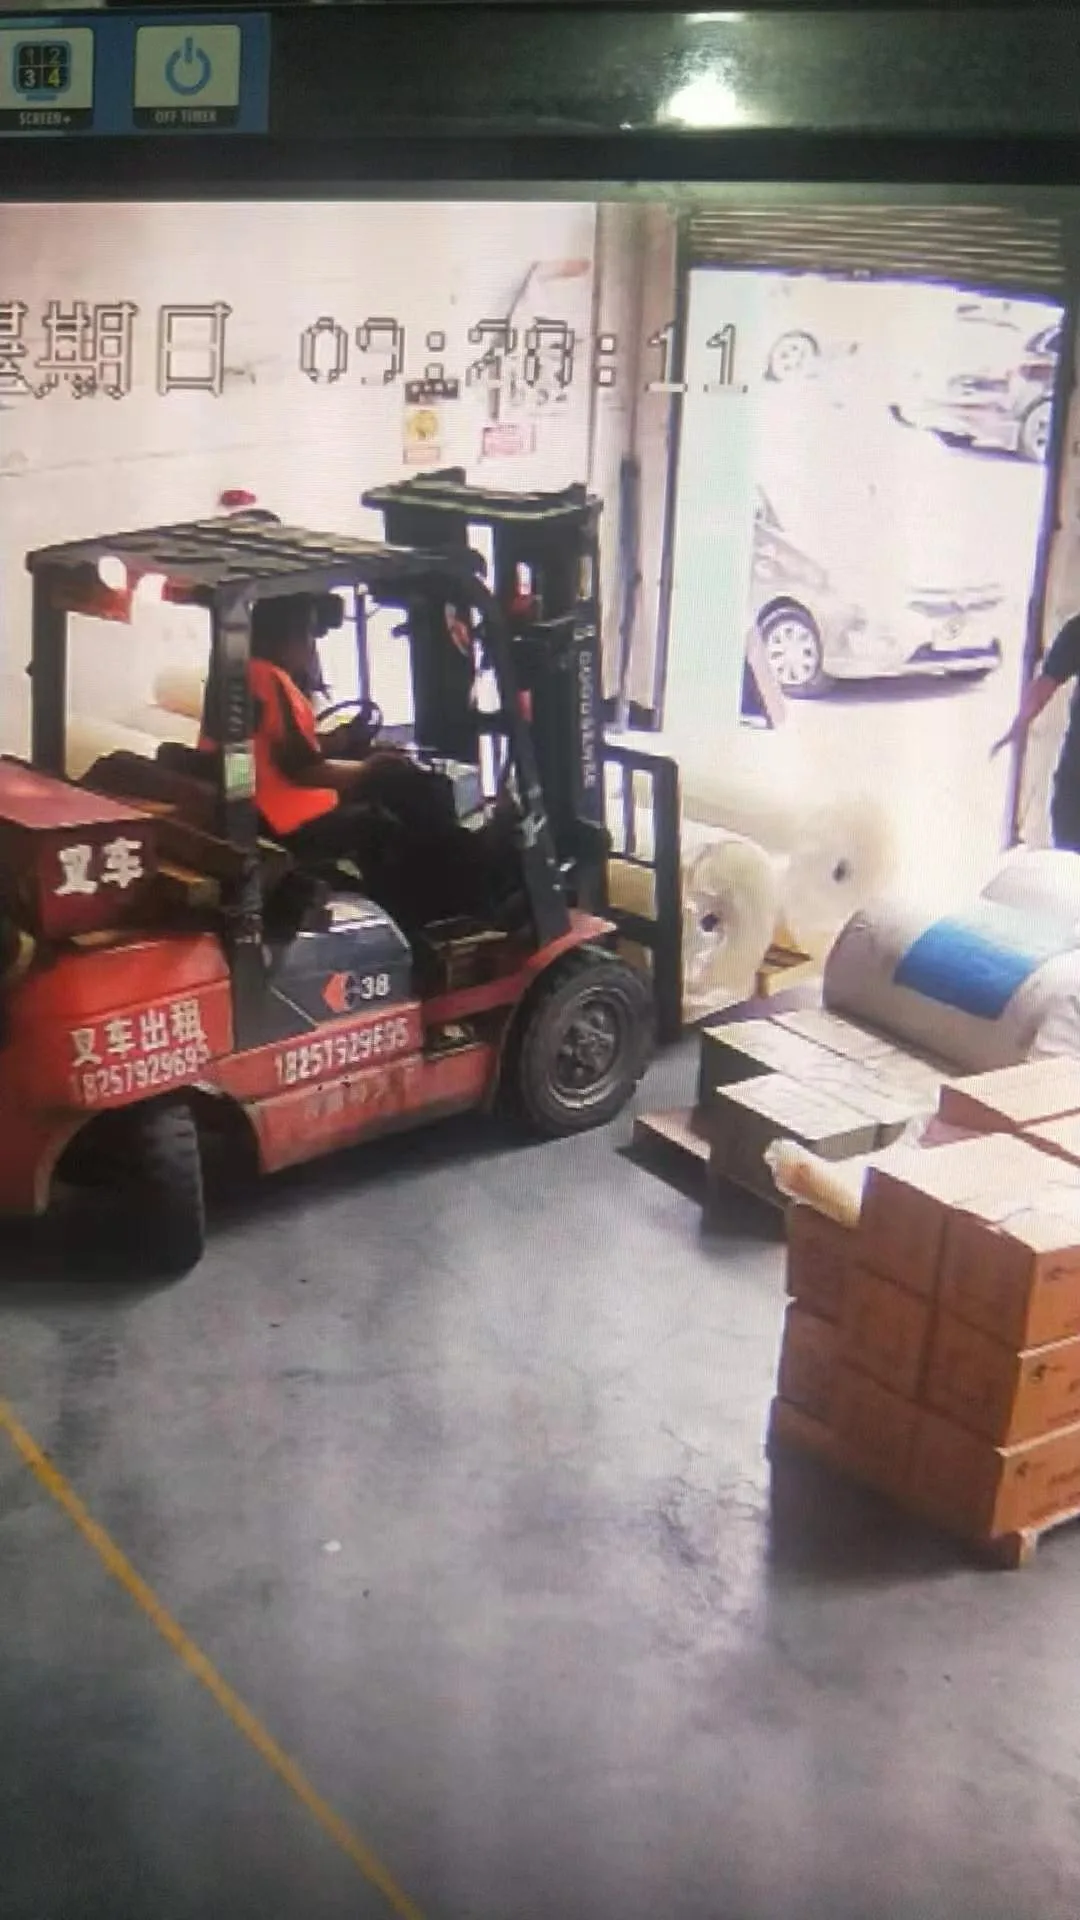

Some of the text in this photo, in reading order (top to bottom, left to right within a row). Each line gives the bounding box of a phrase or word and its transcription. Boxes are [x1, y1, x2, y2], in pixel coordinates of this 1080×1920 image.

[24, 67, 60, 88] 3 4
[155, 109, 216, 123] OFF TIMER
[0, 299, 232, 400] 期日
[55, 837, 144, 895] 叉车
[361, 973, 390, 1000] 38
[70, 998, 207, 1067] 叉车出租
